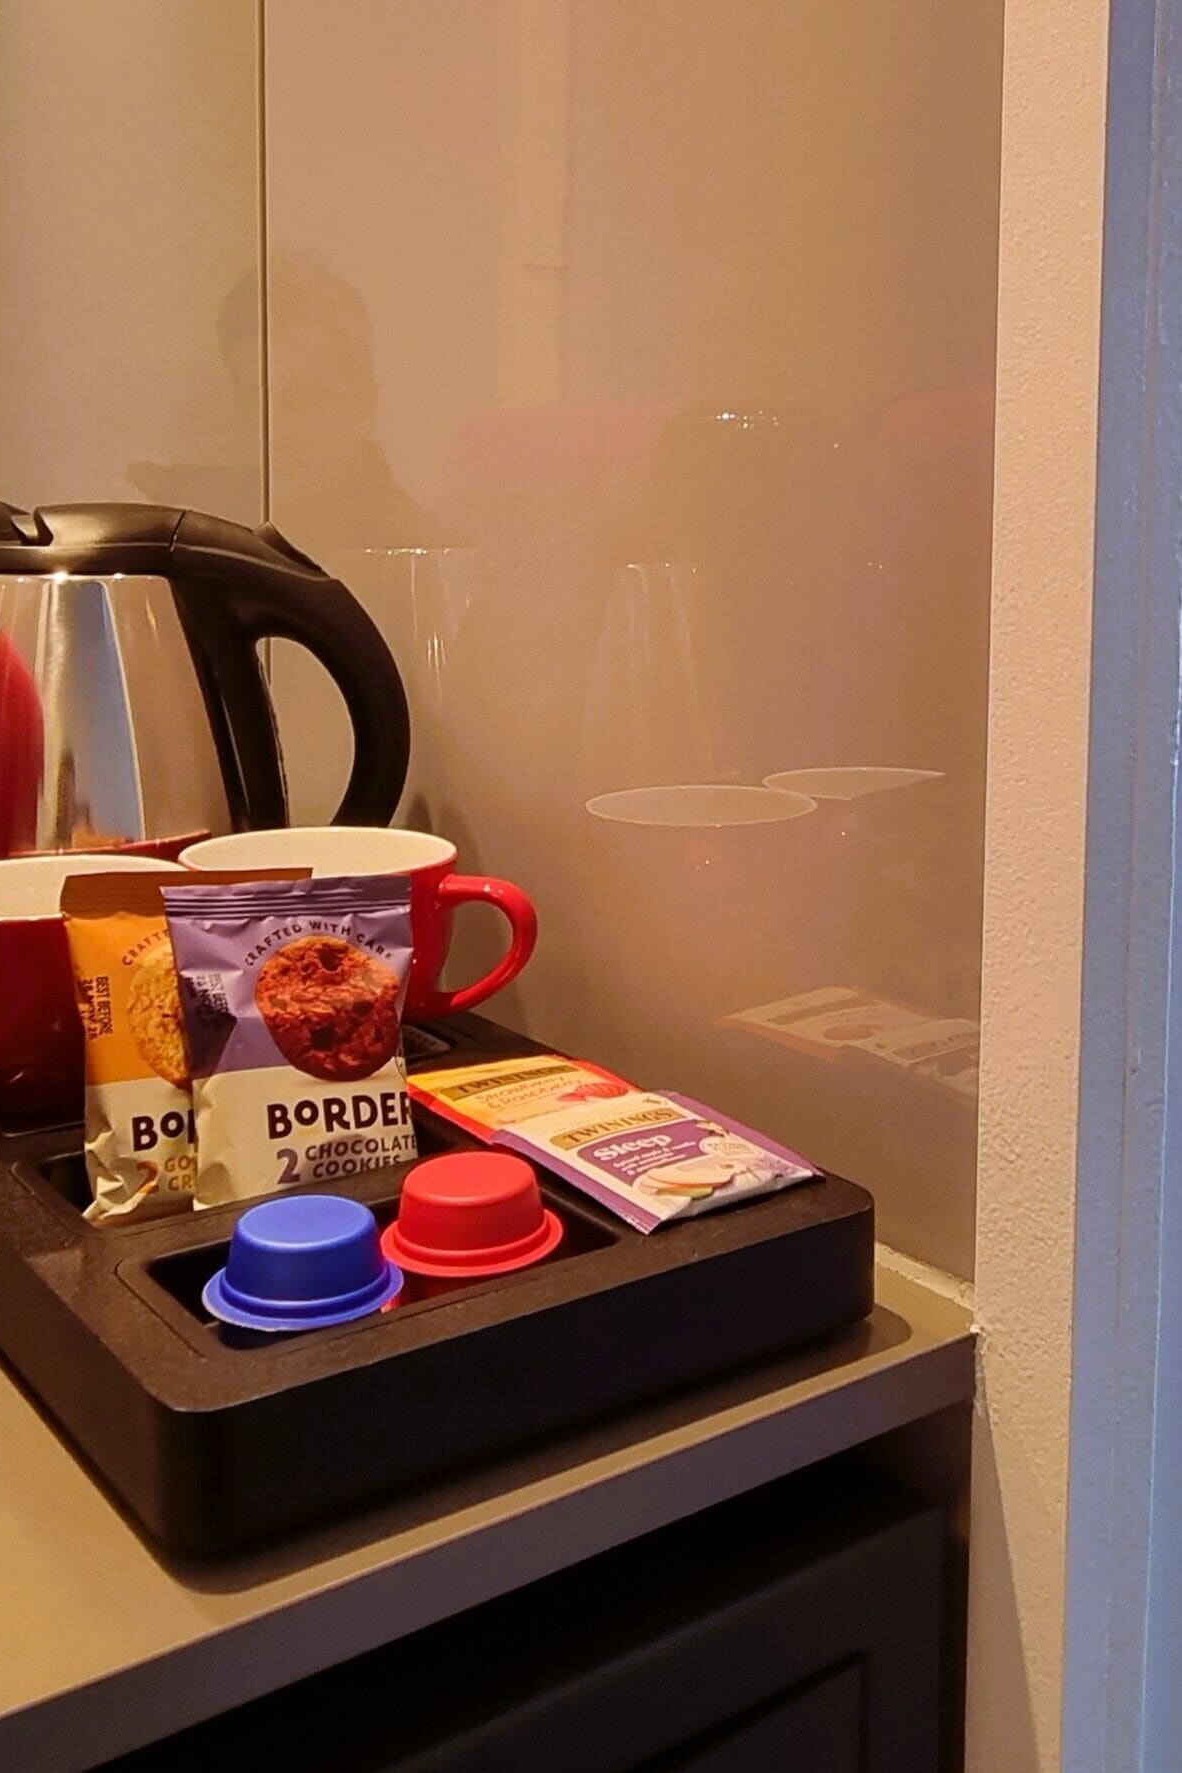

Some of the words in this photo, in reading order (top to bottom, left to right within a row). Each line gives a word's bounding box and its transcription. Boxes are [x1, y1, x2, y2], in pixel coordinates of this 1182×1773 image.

[245, 922, 302, 966] CRAFTED
[309, 921, 352, 936] WITH
[96, 976, 110, 997] BEST
[97, 1000, 114, 1036] BEFORE
[132, 1109, 195, 1152] BO
[563, 1109, 673, 1143] TWININGS
[593, 1134, 672, 1161] Sleep
[276, 1148, 300, 1185] 2
